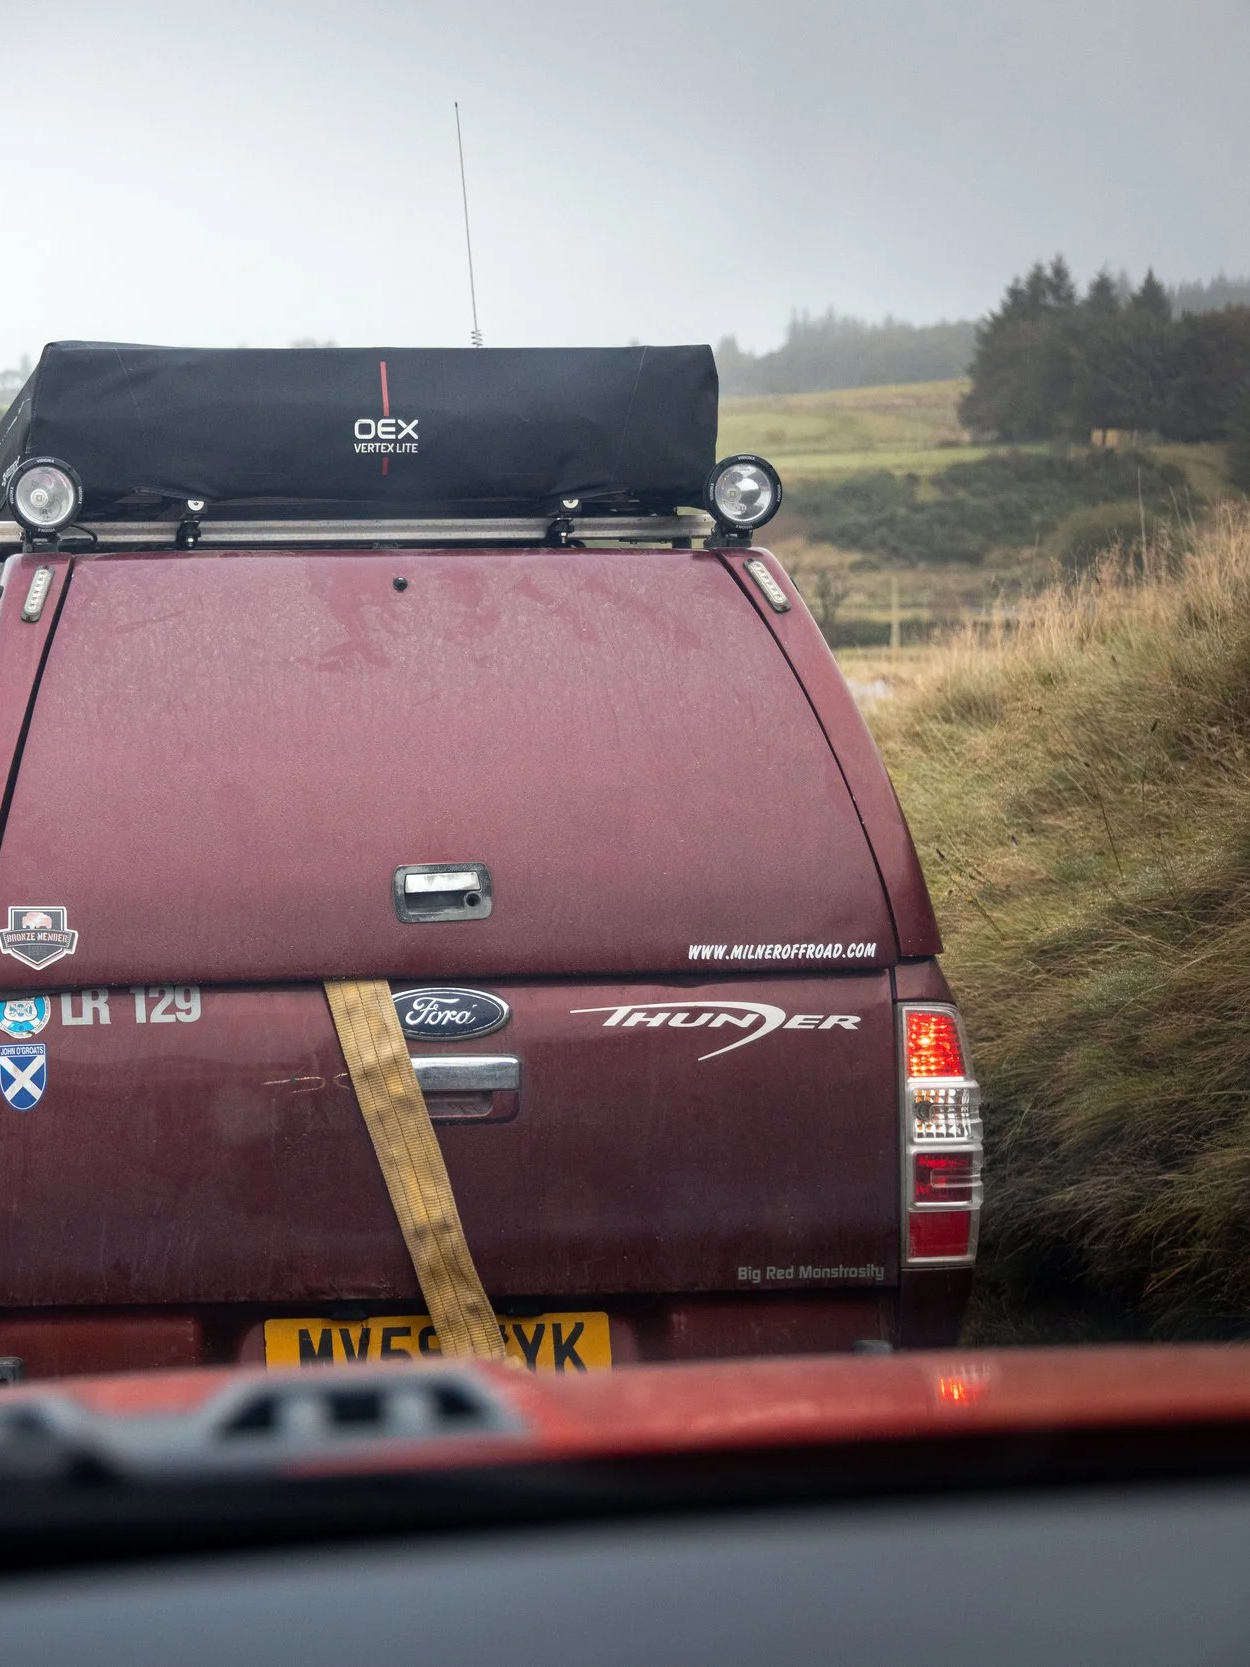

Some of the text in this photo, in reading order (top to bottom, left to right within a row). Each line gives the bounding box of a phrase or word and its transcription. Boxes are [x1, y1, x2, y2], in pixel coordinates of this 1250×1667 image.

[354, 418, 419, 440] OEX
[354, 442, 418, 453] VERTEX LITE
[6, 932, 67, 943] BRONZE MEMBER
[688, 942, 877, 960] WWW.MILNEROFFROAD.COM
[61, 988, 111, 1026] LR
[129, 985, 201, 1024] 129
[405, 996, 478, 1025] Ford
[570, 1001, 861, 1061] THUNDER
[1, 1046, 44, 1056] JOHN O'GROATS
[738, 1264, 885, 1284] Big Red Monstrosity
[502, 1322, 589, 1375] YK
